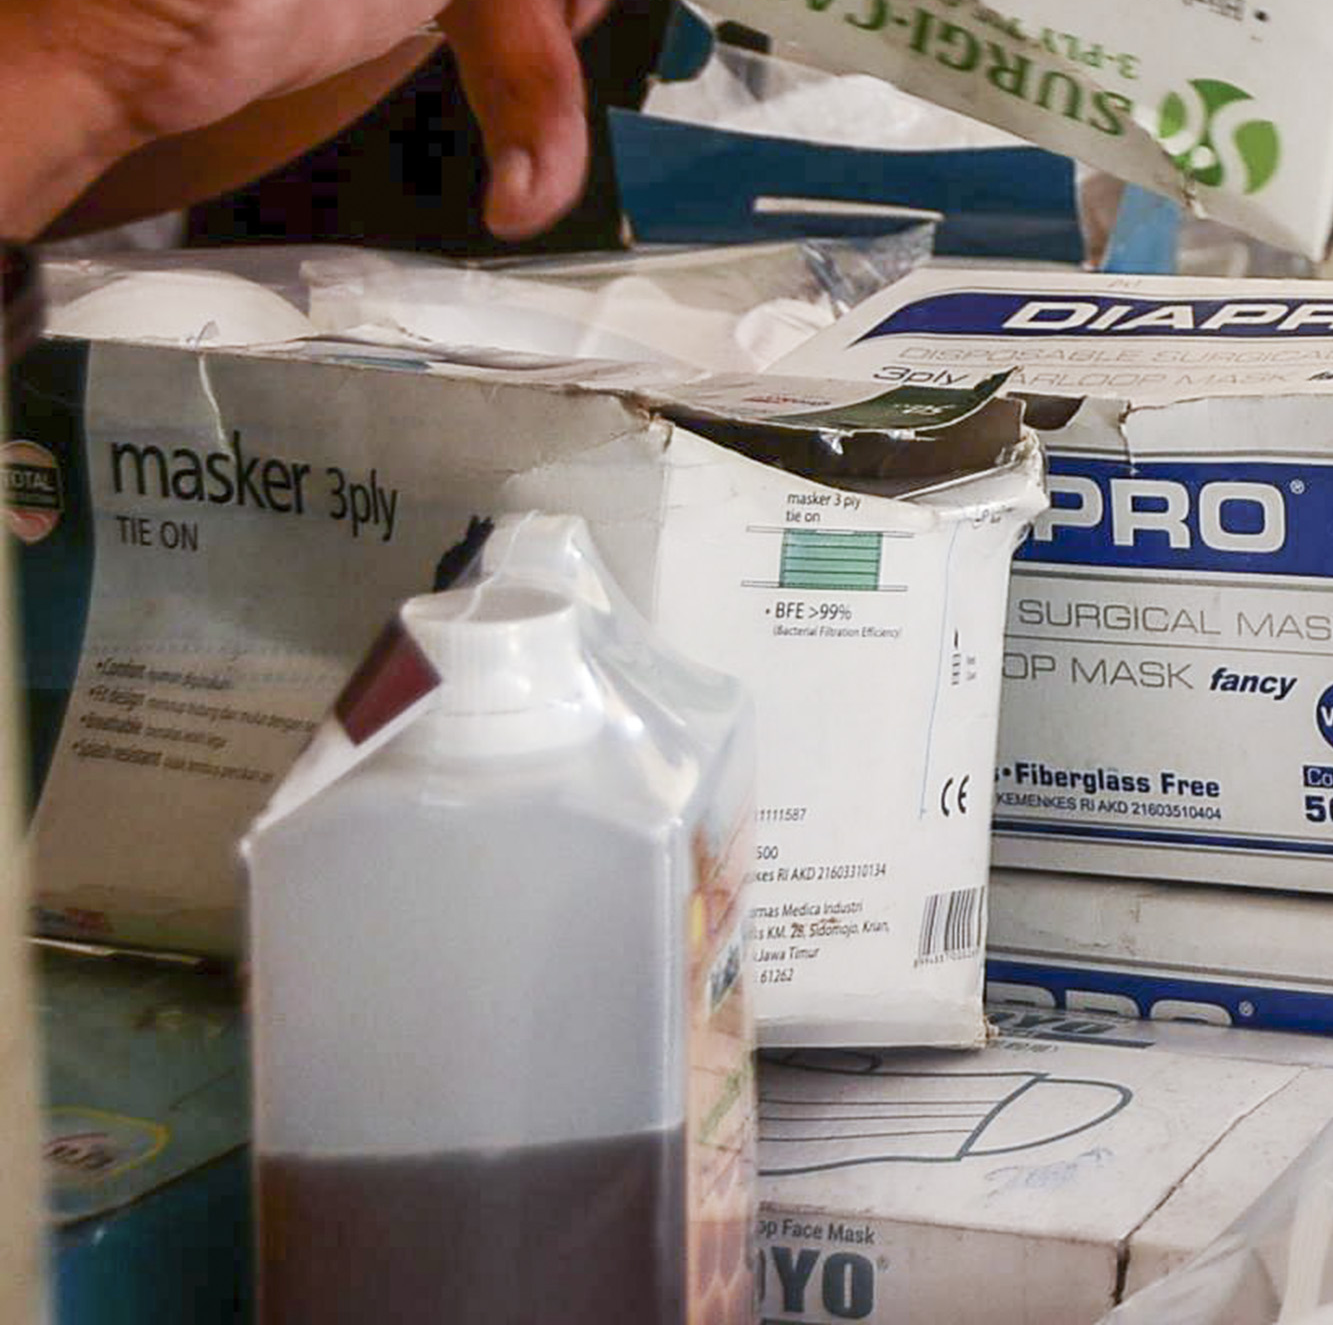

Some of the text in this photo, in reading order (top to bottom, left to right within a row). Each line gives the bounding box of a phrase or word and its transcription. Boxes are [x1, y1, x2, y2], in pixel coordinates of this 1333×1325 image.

[900, 346, 1147, 363] DISPOSABLE
[874, 365, 969, 385] 3ply
[1008, 371, 1162, 387] ARLOOP
[109, 431, 399, 542] masker 3ply
[787, 492, 862, 510] masker 3 ply
[785, 509, 821, 523] tie on
[116, 515, 199, 551] TIE ON
[775, 601, 852, 621] BFE >99%
[1018, 599, 1221, 636] SURGICAL
[1071, 657, 1195, 690] MASK
[1209, 667, 1297, 700] fancy
[1014, 763, 1220, 799] Fiberglass Free
[1080, 796, 1095, 812] RI
[1097, 797, 1129, 815] AKD
[790, 867, 816, 882] AKD
[781, 903, 821, 918] Medica
[788, 946, 820, 961] Timur
[760, 968, 795, 984] 61262
[781, 1218, 824, 1241] Face
[828, 1222, 875, 1245] Mask
[758, 1245, 875, 1320] YO
